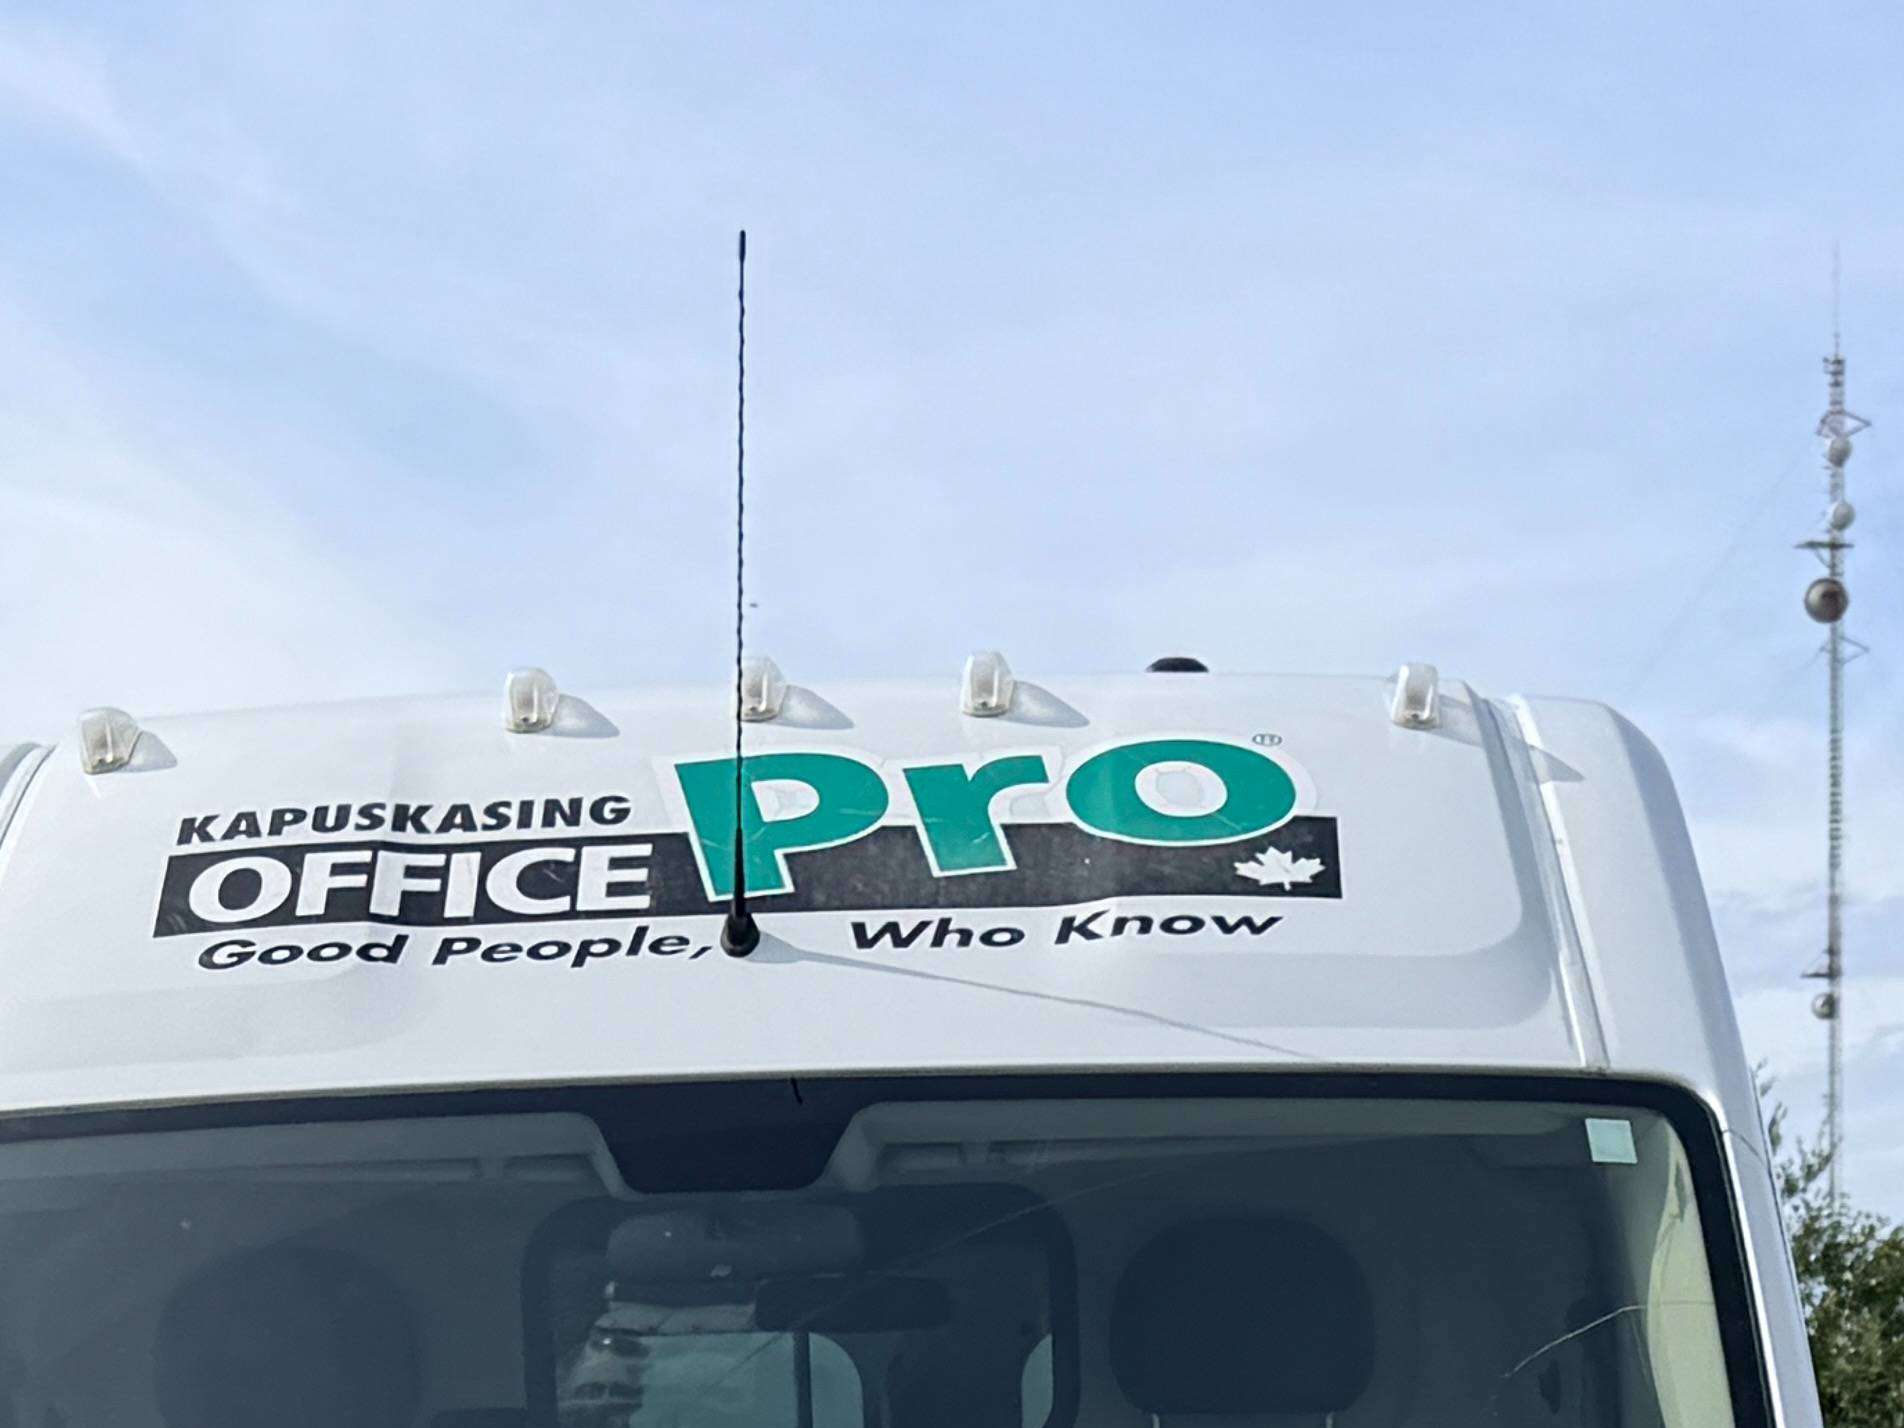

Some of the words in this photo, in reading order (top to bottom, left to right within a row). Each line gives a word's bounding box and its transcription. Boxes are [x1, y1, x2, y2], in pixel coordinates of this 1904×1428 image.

[177, 796, 630, 845] KAPUSKASING
[189, 842, 652, 923] OFFICE
[198, 935, 407, 970] Good
[432, 926, 713, 968] People,
[851, 919, 1024, 950] Who
[1054, 909, 1283, 943] Know
